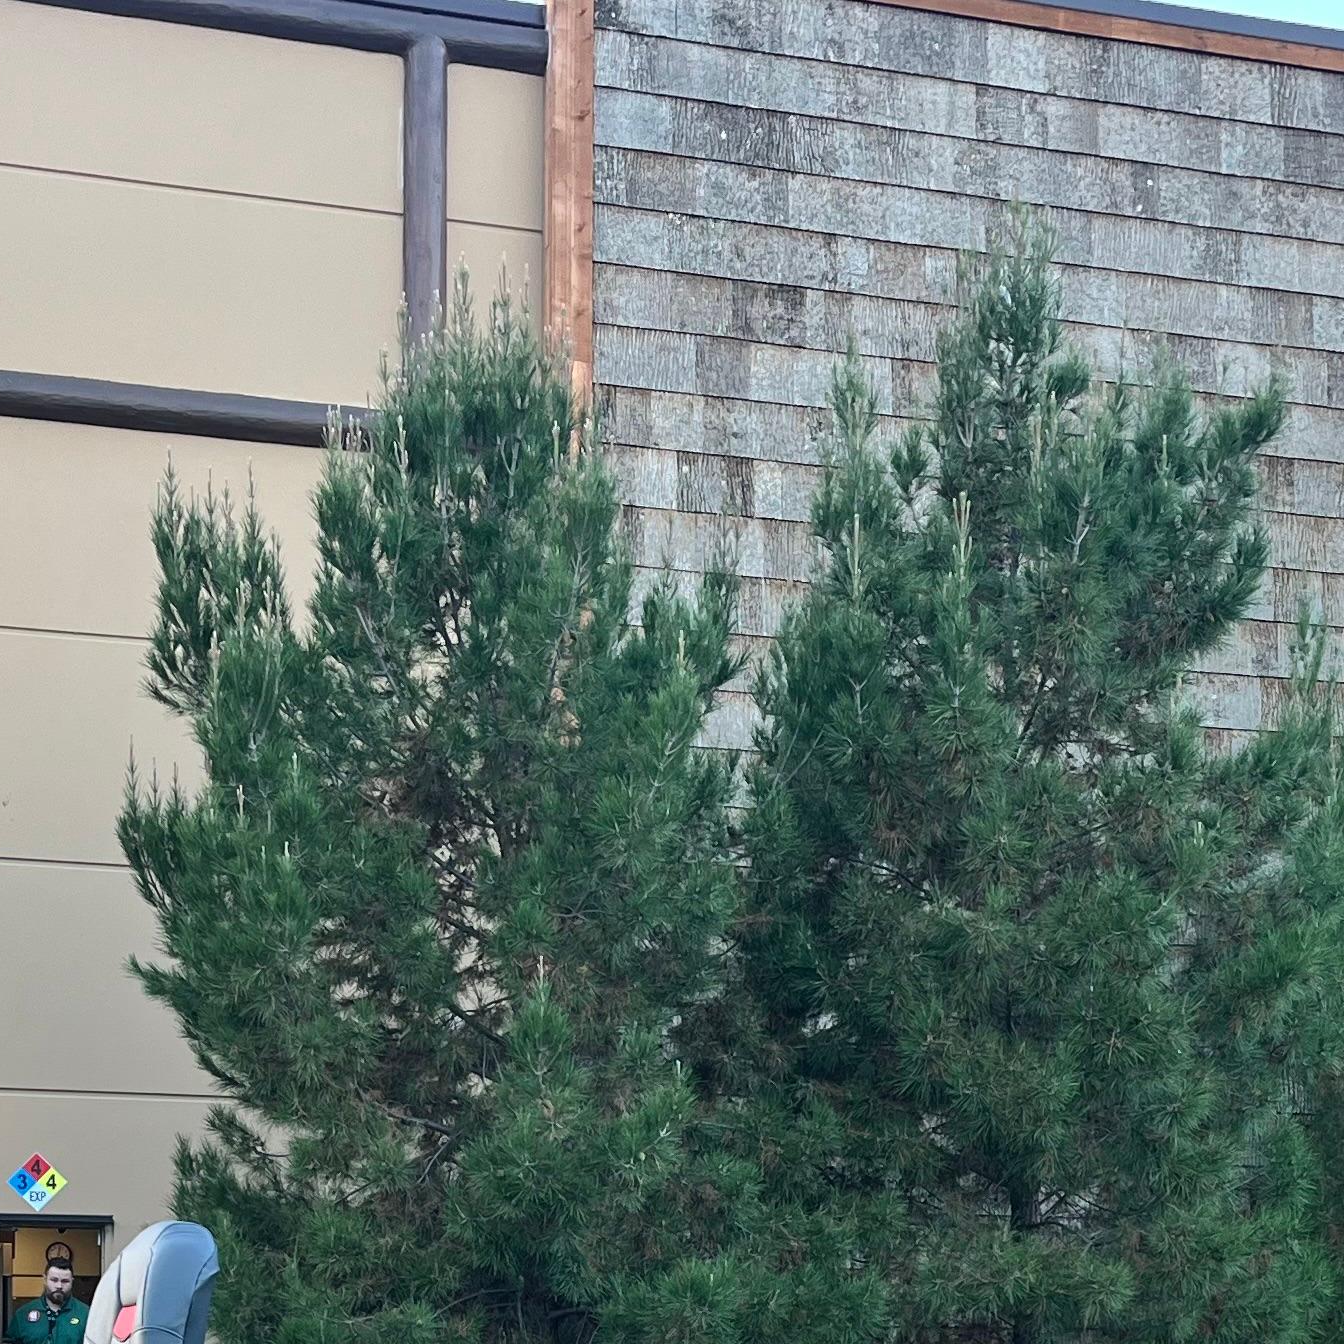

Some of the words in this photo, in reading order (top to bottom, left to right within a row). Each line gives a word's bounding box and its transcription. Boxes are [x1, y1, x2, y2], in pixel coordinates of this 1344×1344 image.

[31, 1160, 42, 1175] 4
[17, 1174, 27, 1190] 3
[46, 1174, 57, 1190] 4
